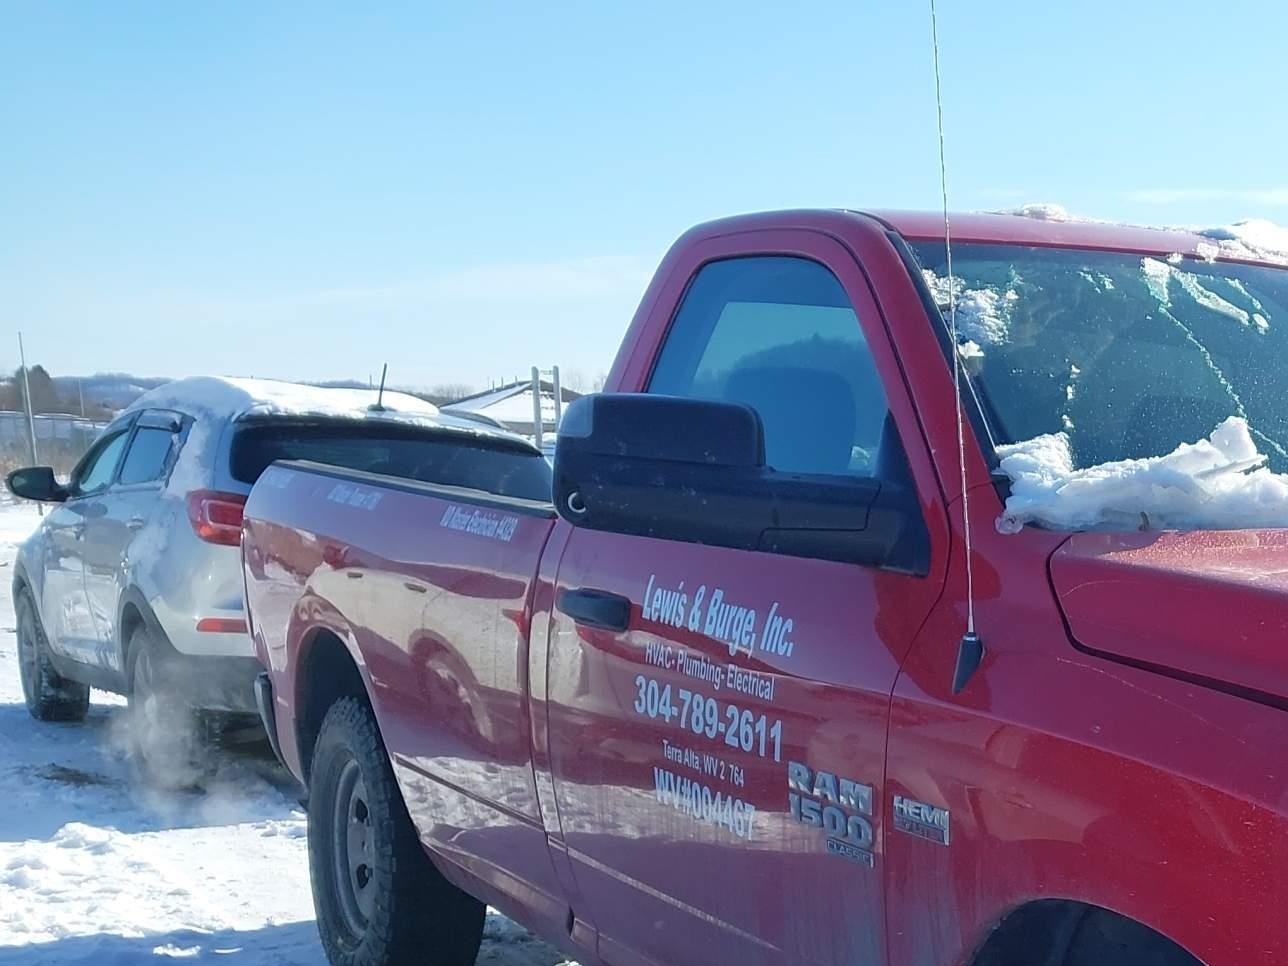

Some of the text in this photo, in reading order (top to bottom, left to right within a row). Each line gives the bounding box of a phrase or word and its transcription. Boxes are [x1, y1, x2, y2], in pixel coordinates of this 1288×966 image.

[642, 575, 794, 659] Lewis & Burge, Inc.
[726, 664, 775, 701] Electrical
[634, 675, 782, 762] 304-789-2611
[663, 739, 682, 763] Terra
[703, 754, 718, 777] WV
[788, 761, 873, 816] RAM
[789, 792, 873, 849] 1500
[893, 795, 949, 840] HEMI
[827, 839, 873, 867] CLASSIC
